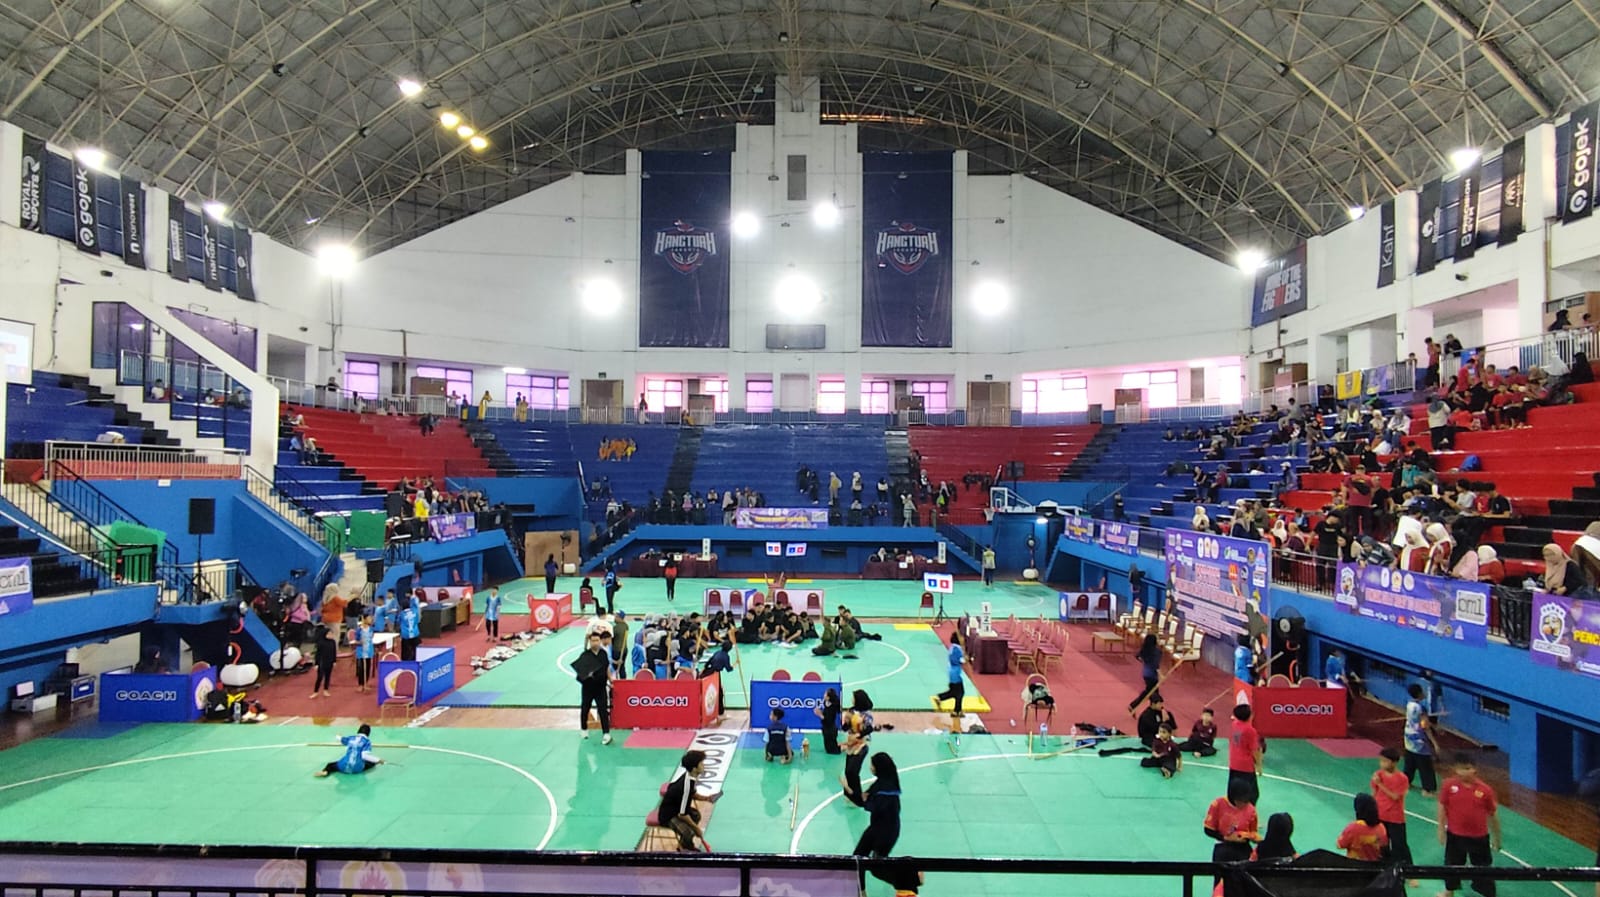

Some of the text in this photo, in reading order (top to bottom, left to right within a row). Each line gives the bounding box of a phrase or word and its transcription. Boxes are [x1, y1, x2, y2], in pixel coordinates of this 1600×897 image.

[1574, 117, 1591, 187] gojek
[22, 180, 31, 220] ROYAL
[31, 174, 40, 224] SPORTS
[76, 167, 93, 226] gojek
[116, 690, 177, 701] COACH
[627, 696, 688, 707] COACH
[1271, 704, 1333, 715] COACH
